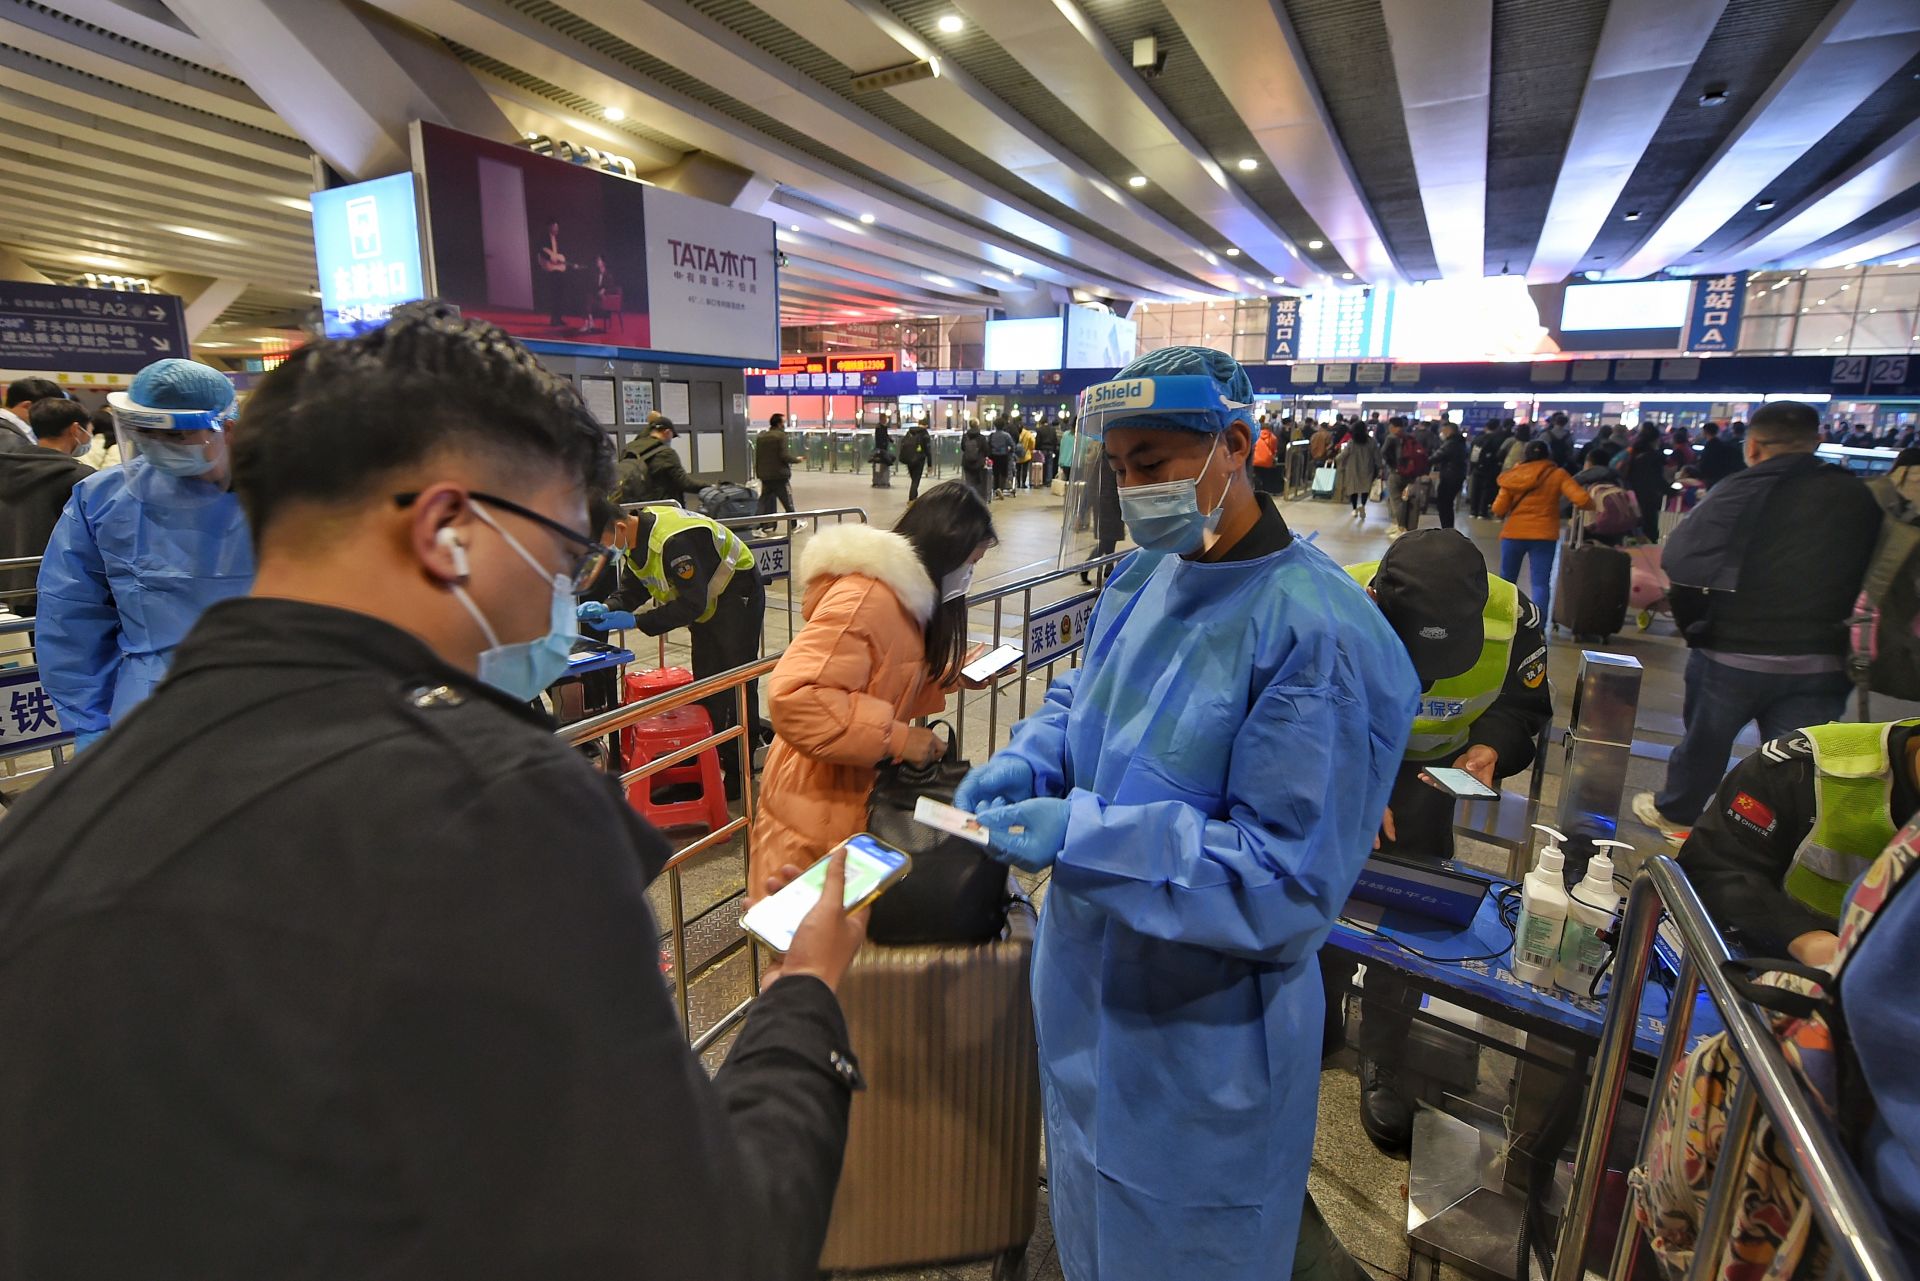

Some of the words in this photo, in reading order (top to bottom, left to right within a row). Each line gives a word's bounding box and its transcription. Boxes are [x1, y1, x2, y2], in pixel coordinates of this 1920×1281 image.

[667, 238, 756, 281] TATA木门
[102, 302, 127, 318] A2
[1701, 273, 1736, 343] 进站口A
[1833, 359, 1863, 381] 24
[1873, 359, 1905, 381] 25
[1096, 382, 1142, 402] Shield
[760, 548, 783, 572] 公安
[1031, 620, 1057, 654] 深铁
[0, 687, 57, 736] 铁
